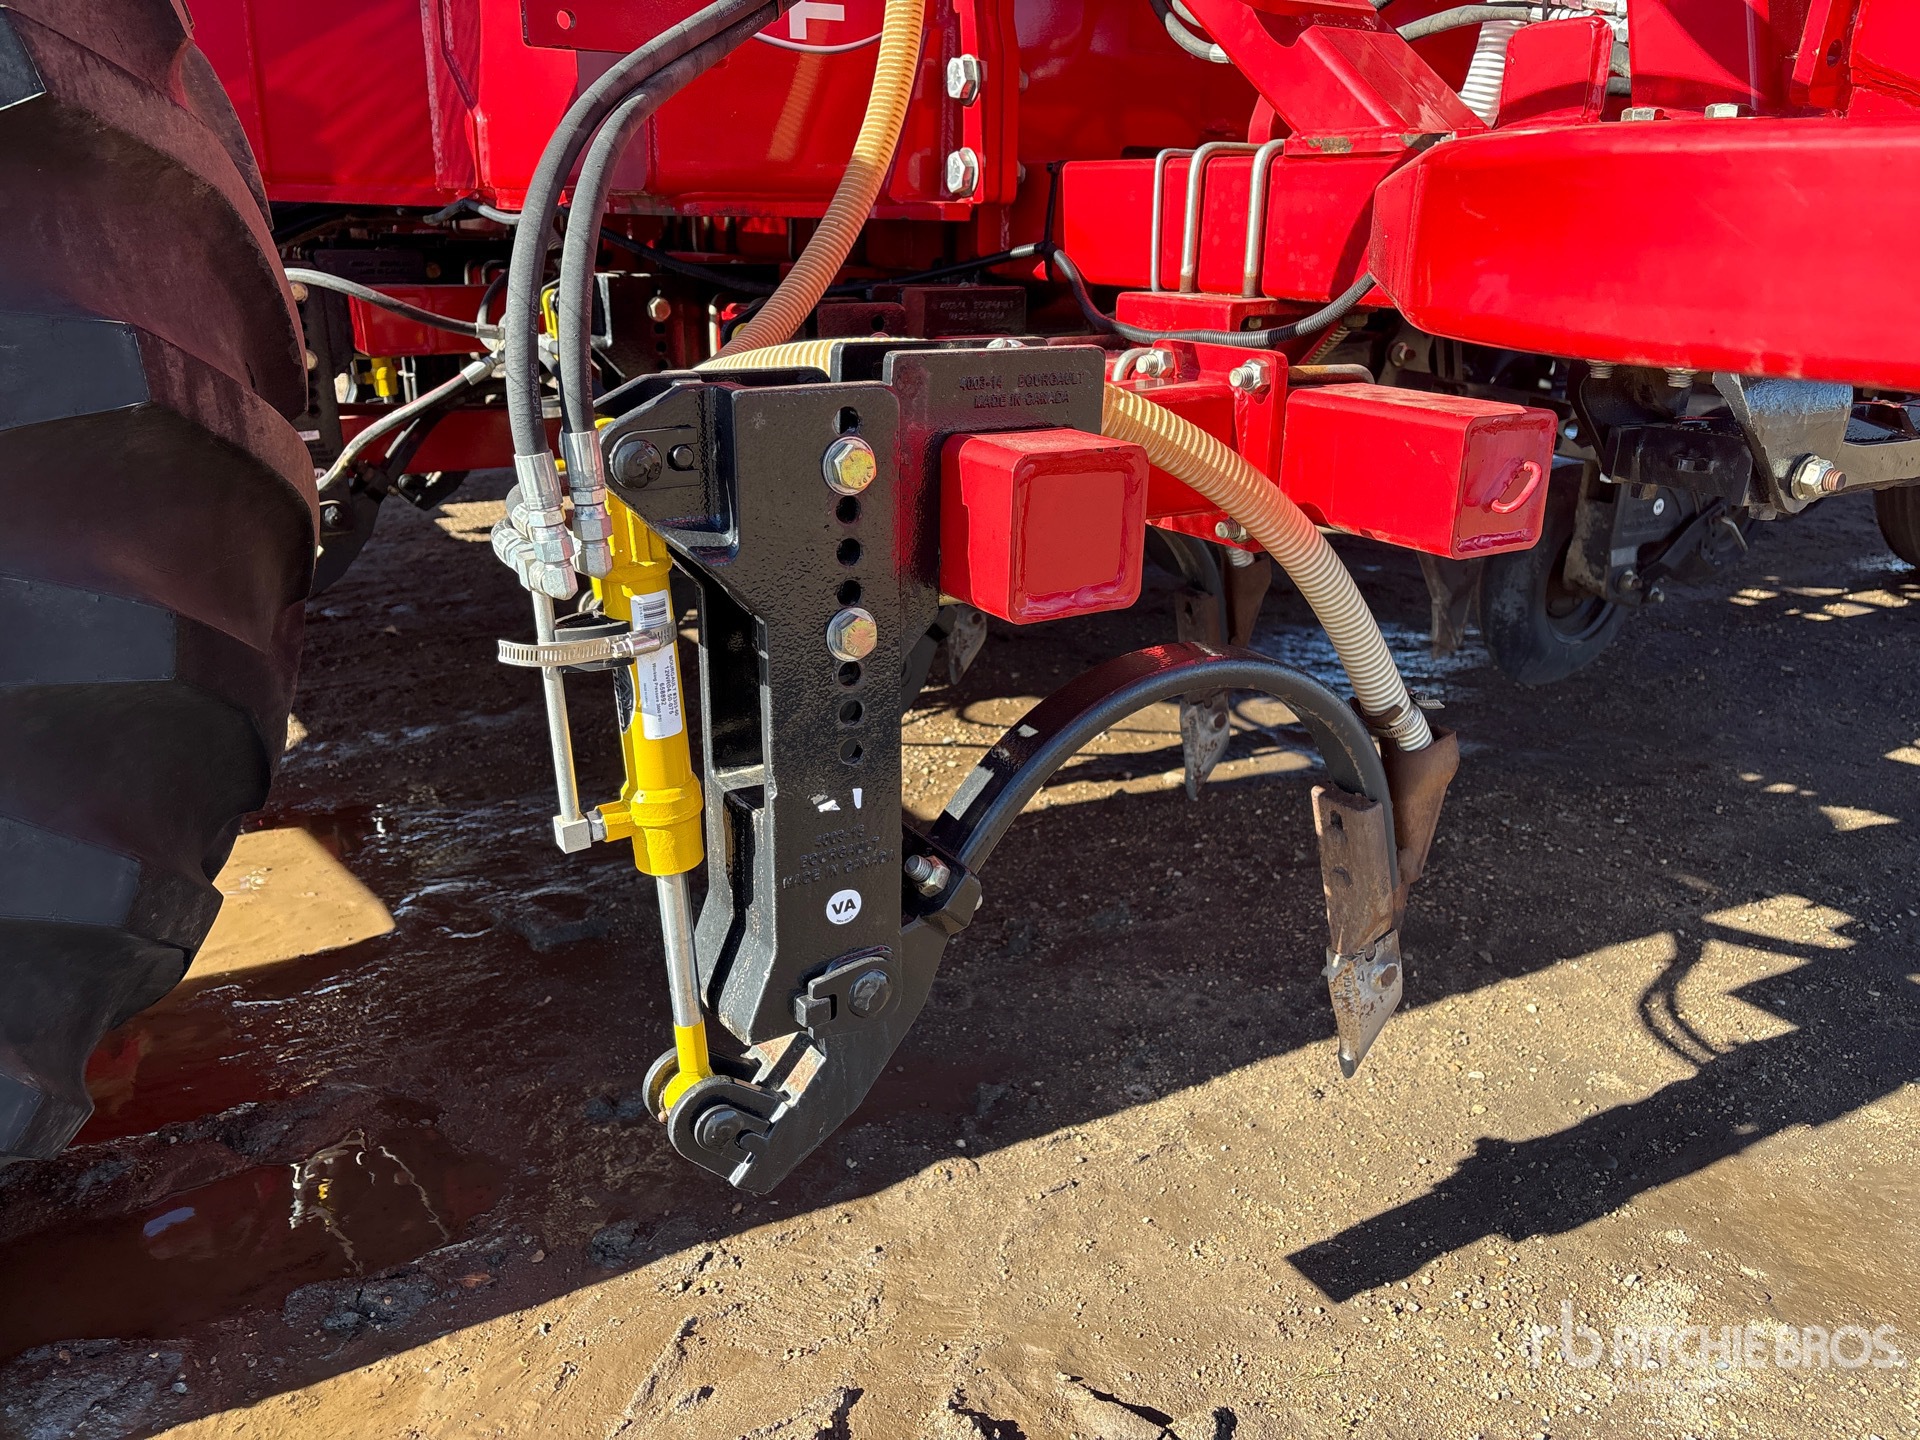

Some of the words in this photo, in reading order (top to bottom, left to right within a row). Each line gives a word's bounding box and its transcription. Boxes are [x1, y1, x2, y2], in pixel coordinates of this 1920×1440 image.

[1017, 371, 1085, 388] BOURGAULT
[974, 393, 1007, 408] MADE
[1009, 393, 1021, 407] IN
[1023, 390, 1070, 406] CANADA
[782, 867, 820, 889] MADE
[844, 849, 896, 873] CANADA
[831, 898, 857, 915] VA
